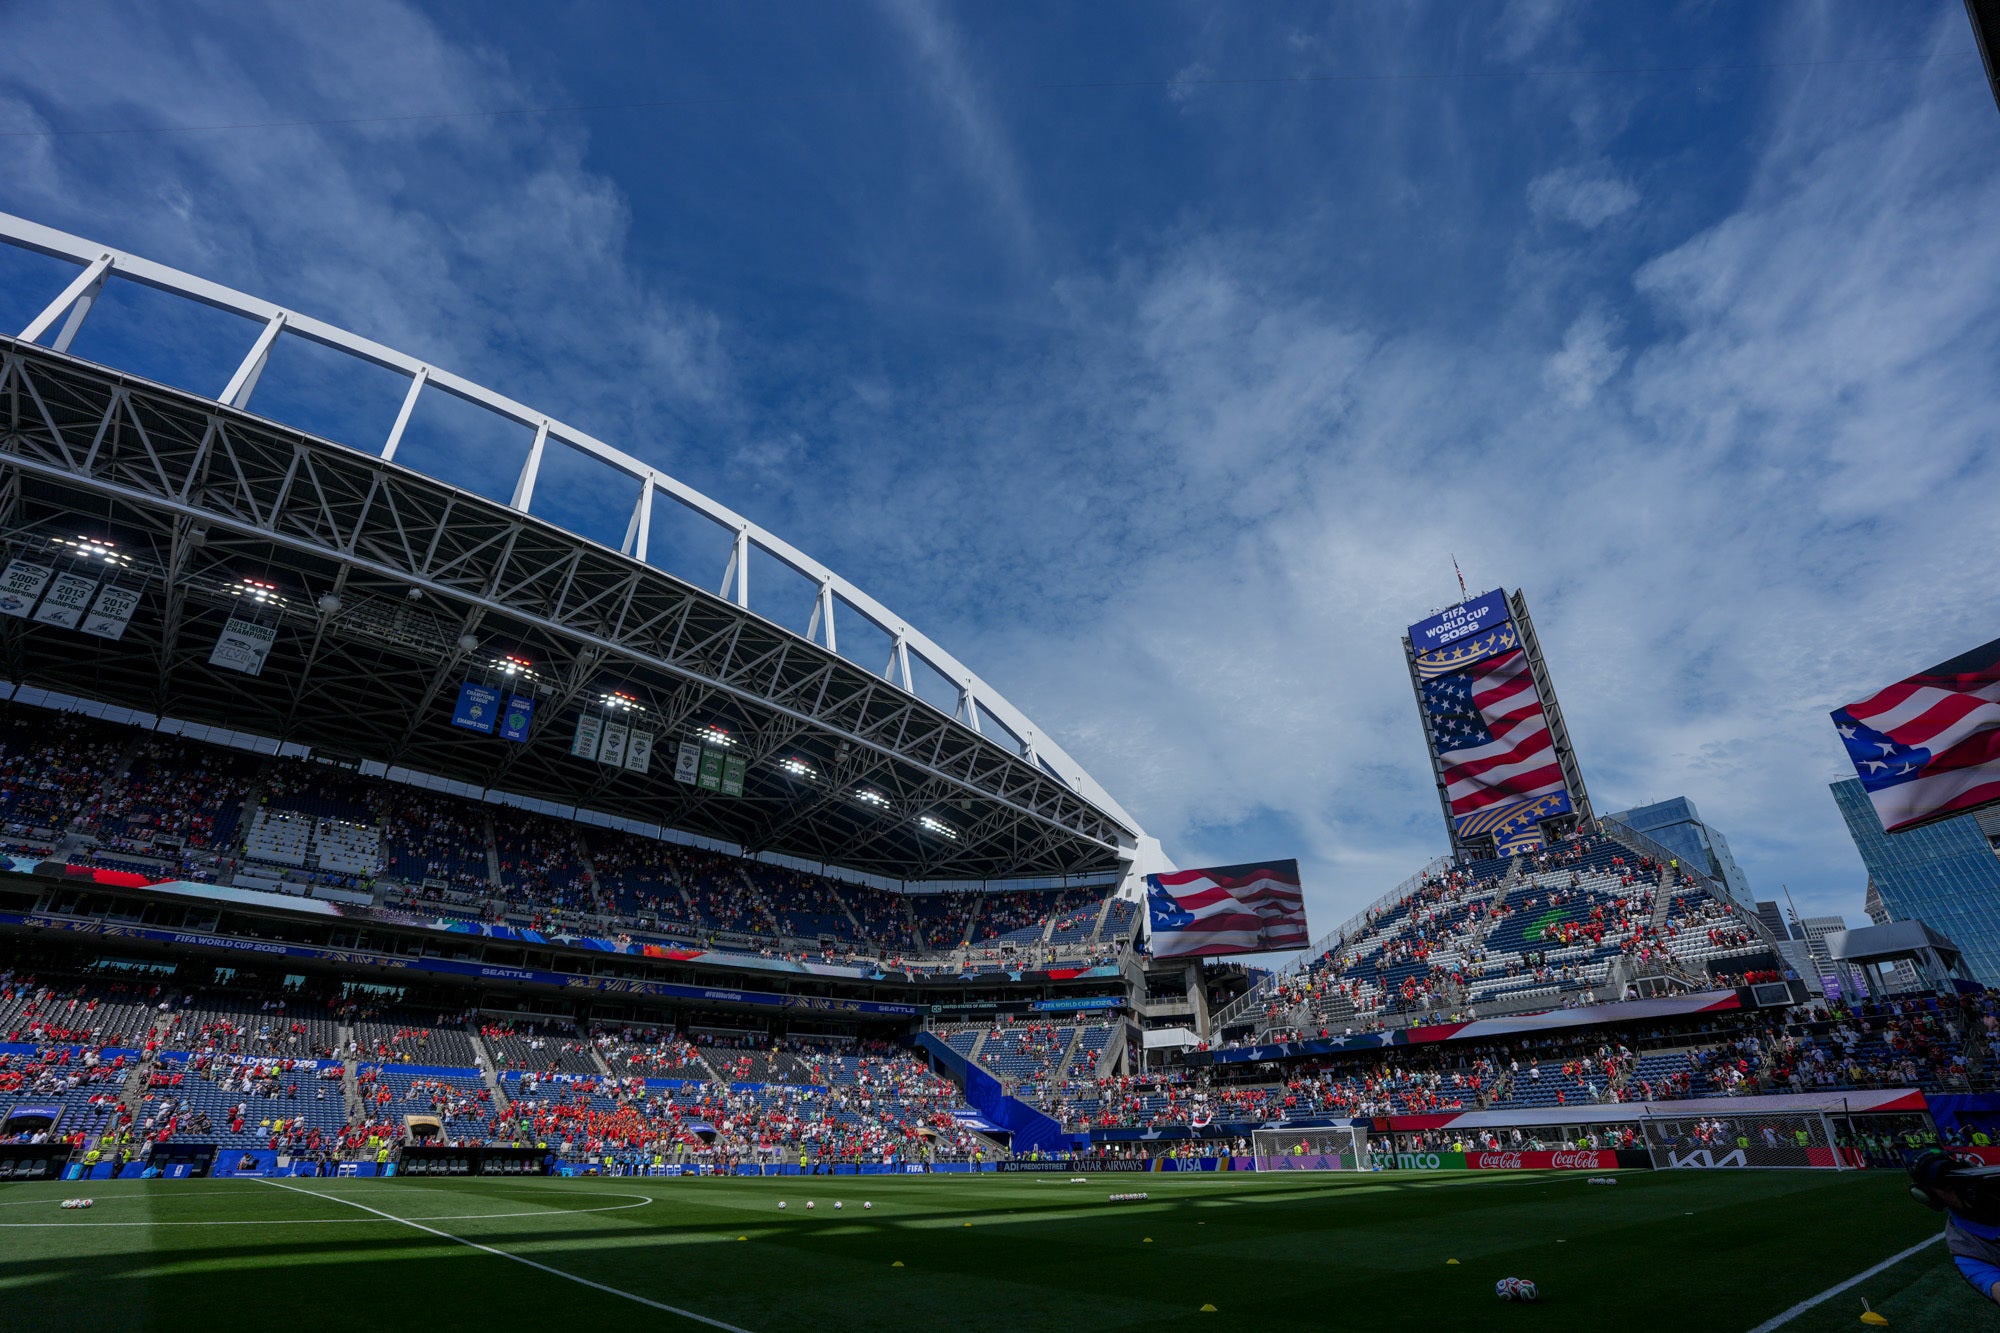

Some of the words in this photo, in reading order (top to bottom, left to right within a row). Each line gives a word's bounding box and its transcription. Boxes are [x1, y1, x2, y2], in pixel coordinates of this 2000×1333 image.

[9, 571, 39, 586] 2005
[9, 580, 32, 592] NFC
[57, 585, 86, 599] 2013
[44, 597, 84, 612] CHAMPIONS
[57, 594, 78, 604] NFC
[102, 596, 130, 610] 2014
[90, 609, 129, 623] CHAMPIONS
[103, 605, 125, 616] NFC
[1442, 606, 1467, 621] FIFA
[1426, 617, 1465, 638] WORLD
[1467, 606, 1489, 621] CUP
[226, 625, 273, 641] CHAMPIONS
[229, 620, 249, 629] 2013
[249, 625, 275, 637] WORLD
[1440, 621, 1479, 643] 2026
[466, 689, 495, 701] CHAMPIONS
[470, 696, 489, 705] LEAGUE
[456, 717, 477, 727] CHAMPS
[606, 727, 626, 735] CHAMPS
[632, 733, 651, 742] CHAMPS
[680, 747, 699, 756] SHIELD
[175, 934, 196, 944] FIFA
[199, 937, 233, 947] WORLD
[234, 941, 254, 950] CUP
[254, 944, 287, 954] 2026
[481, 968, 534, 979] SEATTLE
[878, 1005, 915, 1014] SEATTLE
[1056, 1001, 1078, 1009] WORLD
[1091, 999, 1112, 1007] 2026
[1175, 1158, 1201, 1172] VISA
[1479, 1152, 1522, 1169] Coca-Cola
[1552, 1150, 1600, 1168] Coca-Cola
[907, 1165, 923, 1173] FIFA
[1004, 1160, 1020, 1171] ADI
[1020, 1162, 1067, 1171] PREDICTSTREET
[1073, 1160, 1101, 1172] QATAR
[1104, 1160, 1143, 1172] AIRWAYS
